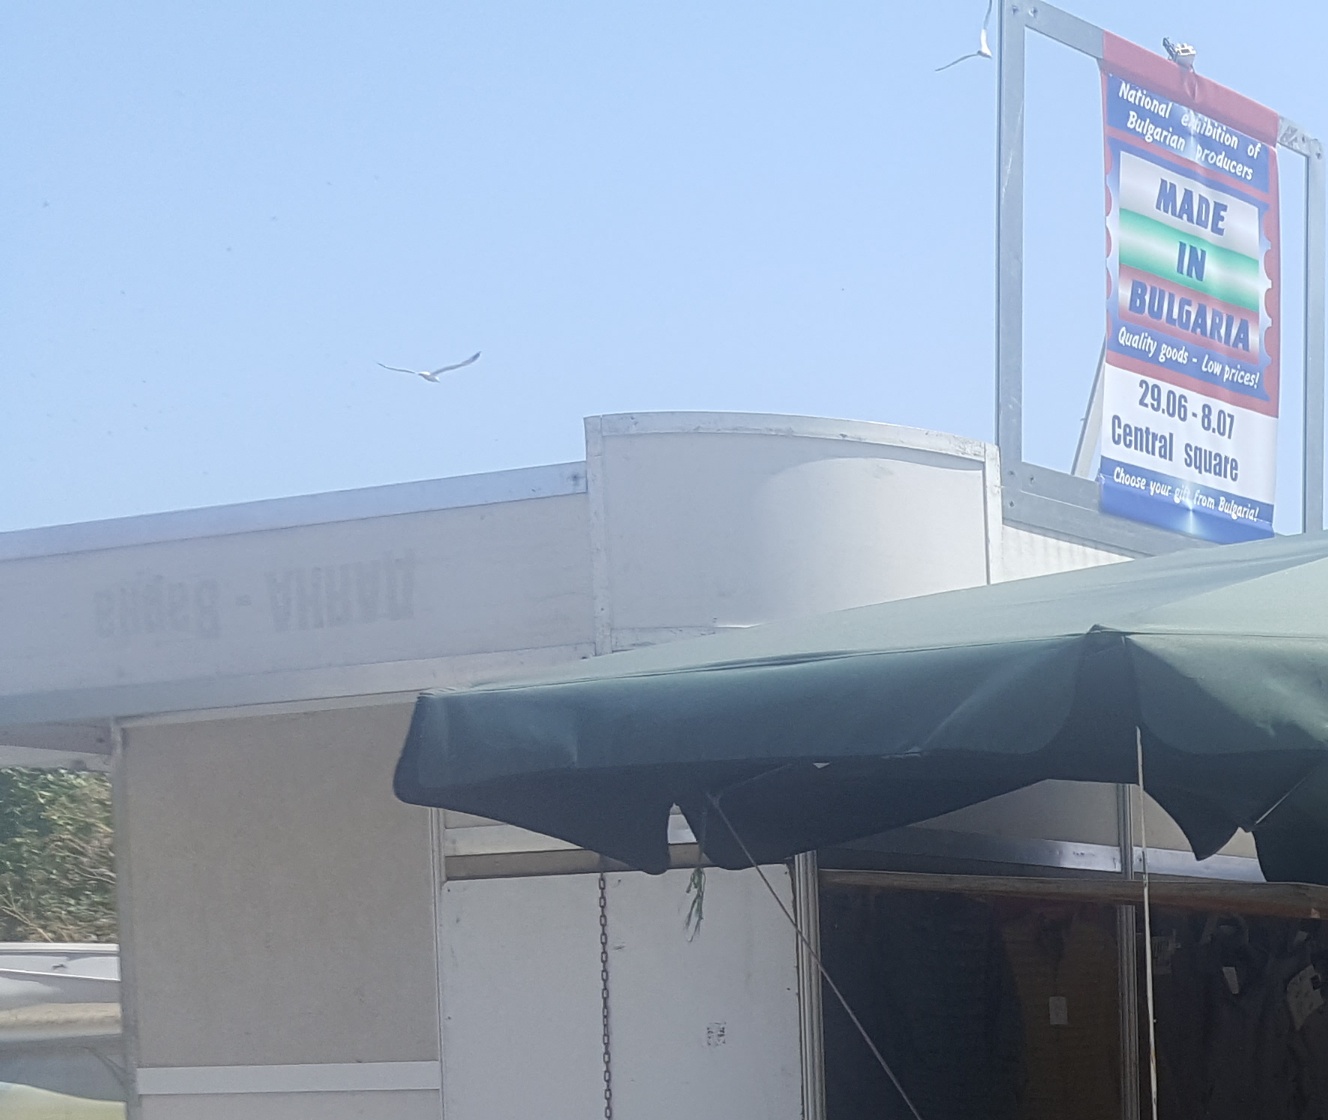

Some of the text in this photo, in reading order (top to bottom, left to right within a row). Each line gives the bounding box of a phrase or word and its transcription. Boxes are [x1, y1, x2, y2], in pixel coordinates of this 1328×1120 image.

[1119, 81, 1172, 118] National
[1247, 142, 1261, 159] of
[1127, 111, 1253, 180] Bulgarian producers
[1155, 178, 1228, 236] MADE
[1177, 241, 1206, 281] IN
[1129, 280, 1250, 352] BULGARIA
[1118, 327, 1157, 357] Quality
[1159, 344, 1189, 364] goods
[1202, 355, 1221, 376] Low
[1223, 364, 1259, 389] prices!
[1138, 379, 1188, 422] 29.06
[1201, 403, 1235, 440] 8.07
[1111, 414, 1239, 482] Central square
[1113, 466, 1146, 490] Choose
[1150, 480, 1170, 496] your
[1193, 488, 1215, 510] from
[1218, 496, 1259, 522] Bulgaria!
